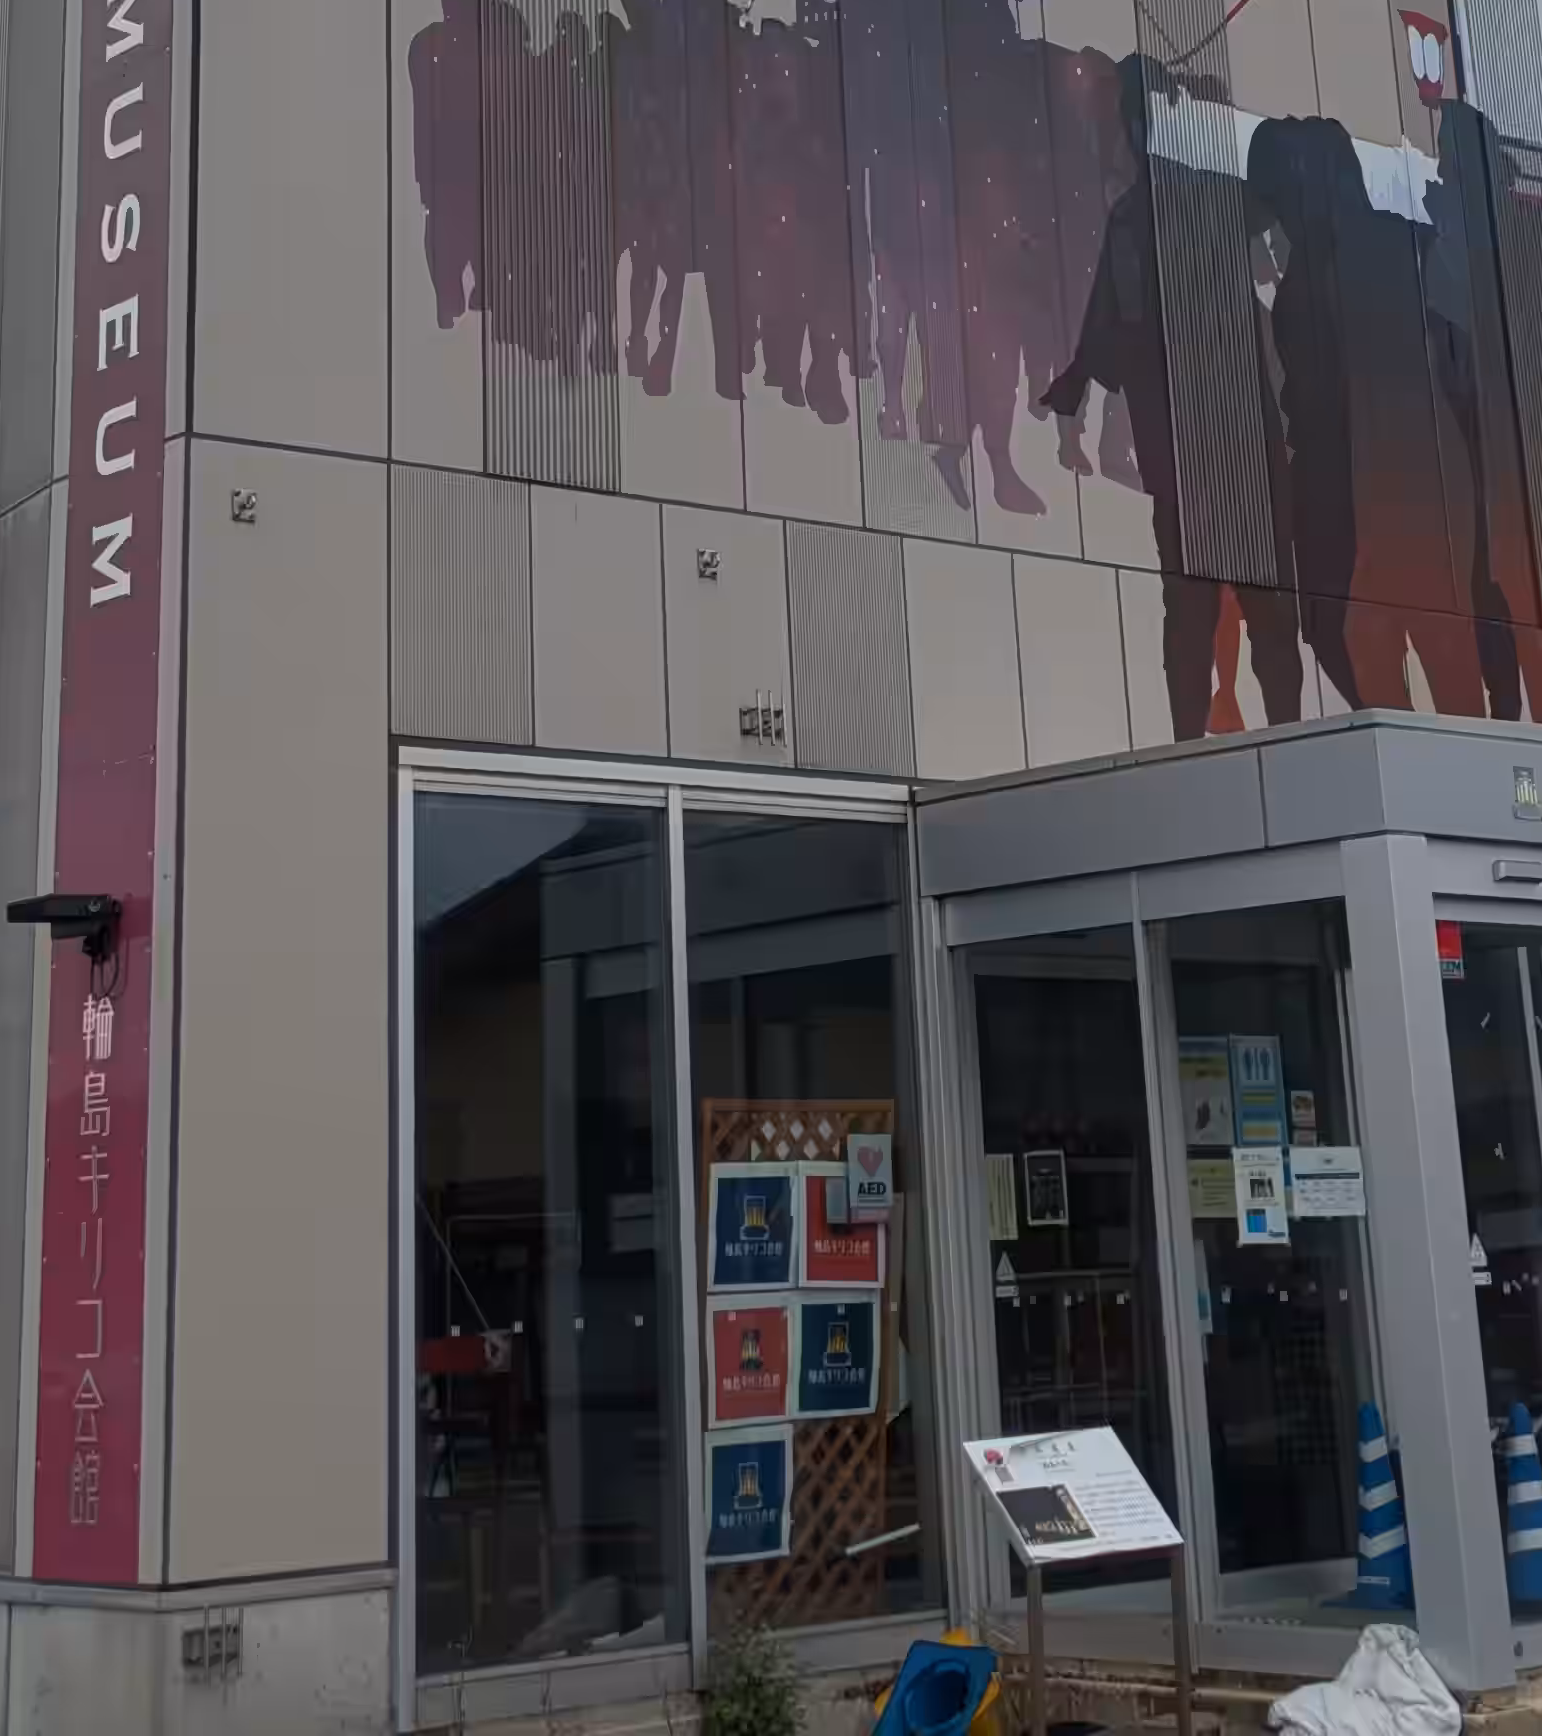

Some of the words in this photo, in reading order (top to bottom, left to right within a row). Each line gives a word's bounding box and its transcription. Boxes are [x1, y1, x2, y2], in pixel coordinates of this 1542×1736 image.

[69, 994, 115, 1525] 輪島キリコ会館
[858, 1181, 887, 1196] AED
